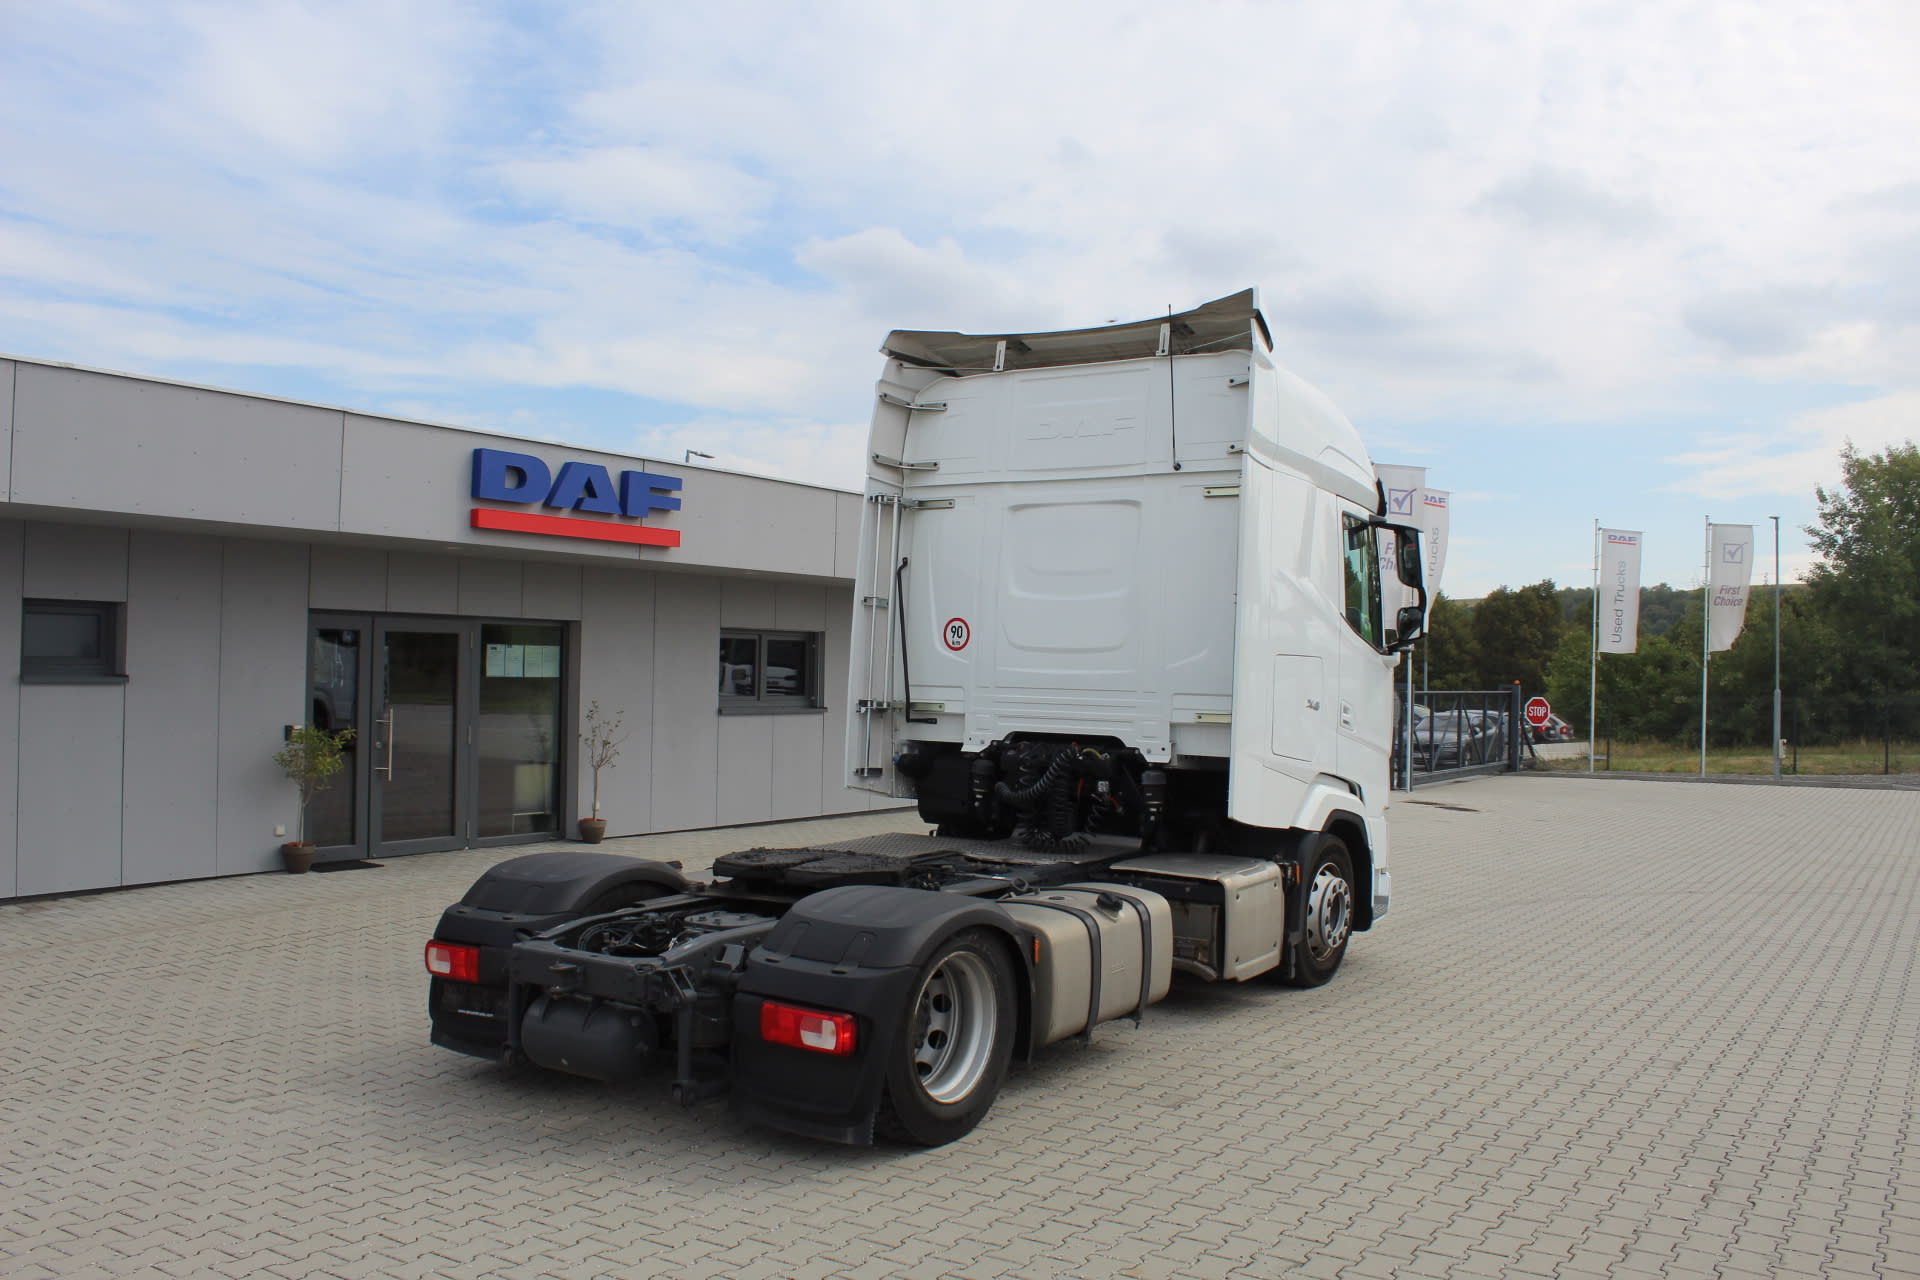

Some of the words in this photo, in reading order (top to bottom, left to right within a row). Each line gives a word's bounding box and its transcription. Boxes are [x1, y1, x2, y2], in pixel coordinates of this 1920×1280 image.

[471, 448, 683, 518] DAF
[1608, 534, 1637, 542] DAF
[1613, 560, 1627, 604] Trucks
[1720, 584, 1741, 595] First
[1713, 595, 1744, 607] Choice
[950, 625, 963, 639] 90
[1610, 608, 1624, 644] Used
[1528, 706, 1546, 717] STOP
